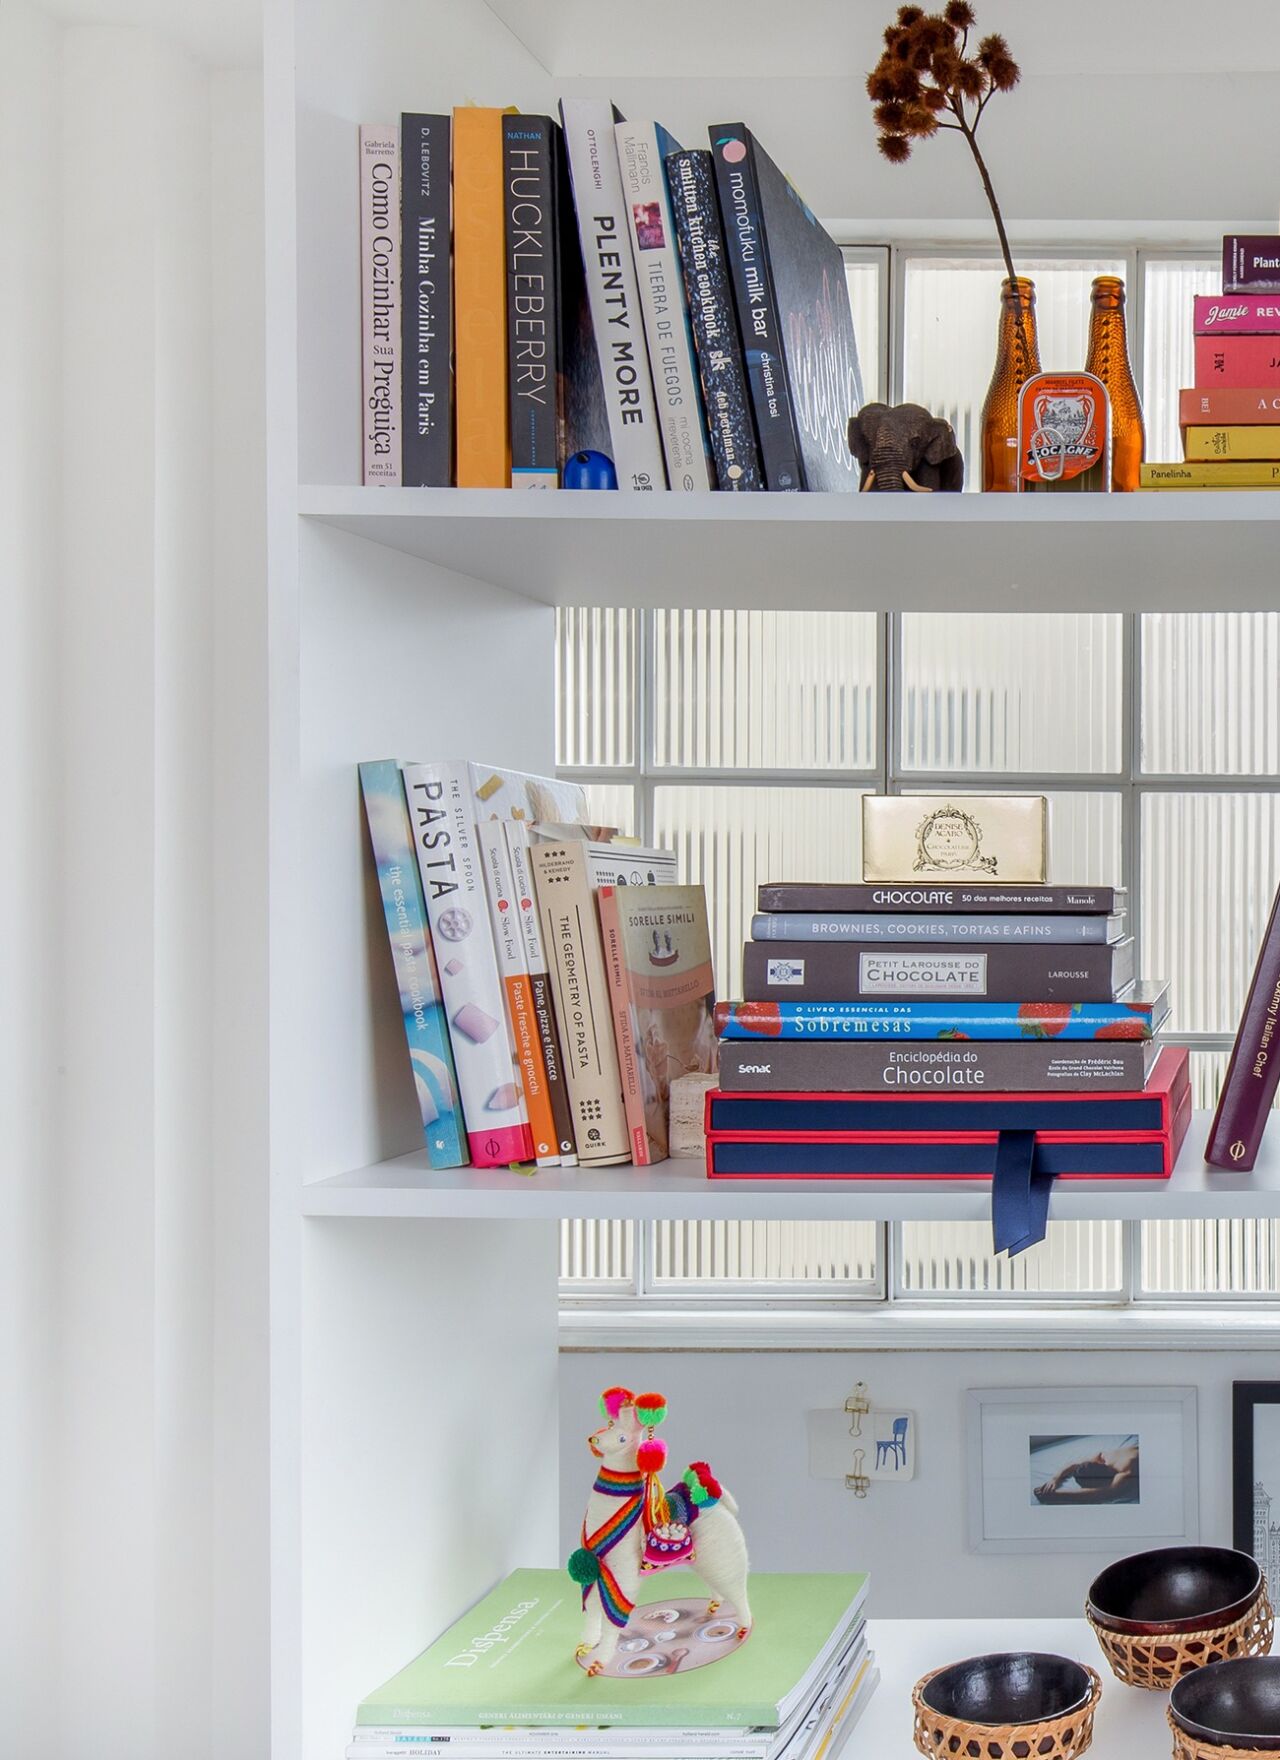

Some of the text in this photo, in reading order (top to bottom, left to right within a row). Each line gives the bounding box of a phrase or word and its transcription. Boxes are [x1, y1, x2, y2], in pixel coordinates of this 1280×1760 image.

[364, 141, 395, 149] Gabriela
[507, 132, 542, 140] NATHAN
[421, 127, 430, 196] D. LEBOVITZ
[587, 129, 602, 190] OTTOLENGHI
[371, 163, 395, 342] Como Cozinhar
[679, 159, 721, 338] smitten kitchen cookbook
[730, 172, 768, 338] momofuku milk bar
[509, 150, 547, 405] HUCKLEBERRY
[418, 217, 436, 435] Minha Cozinha em Paris
[593, 216, 644, 425] PLENTY MORE
[648, 261, 683, 407] TIERRA FUEGOS
[373, 345, 394, 356] Sua
[760, 352, 774, 395] christina
[369, 361, 396, 456] Preguiça
[1151, 469, 1192, 478] Panelinha
[413, 781, 460, 900] PASTA
[934, 823, 963, 831] DENISE
[454, 807, 475, 892] SILVER SPOON
[872, 891, 1053, 904] CHOCOLATE 50 das melhores receitas
[629, 913, 695, 927] SORELLE SIMILI
[812, 923, 1052, 936] BROWNIES, COOKIES, TORTAS AFINS
[613, 963, 622, 988] SIMILI
[867, 969, 979, 982] CHOCOLATE
[868, 960, 979, 969] PETIT LAROUSSE DO
[1048, 971, 1089, 979] LAROUSSE
[559, 916, 589, 1069] THE GEOMETRY OF PASTA
[795, 1016, 912, 1033] Sobremesas
[512, 981, 540, 1096] Paste fresche gnocchi
[889, 1051, 978, 1064] Enciclopédia do
[1252, 1049, 1269, 1078] Chef
[883, 1066, 985, 1085] Chocolate
[585, 1141, 606, 1149] QUIRK
